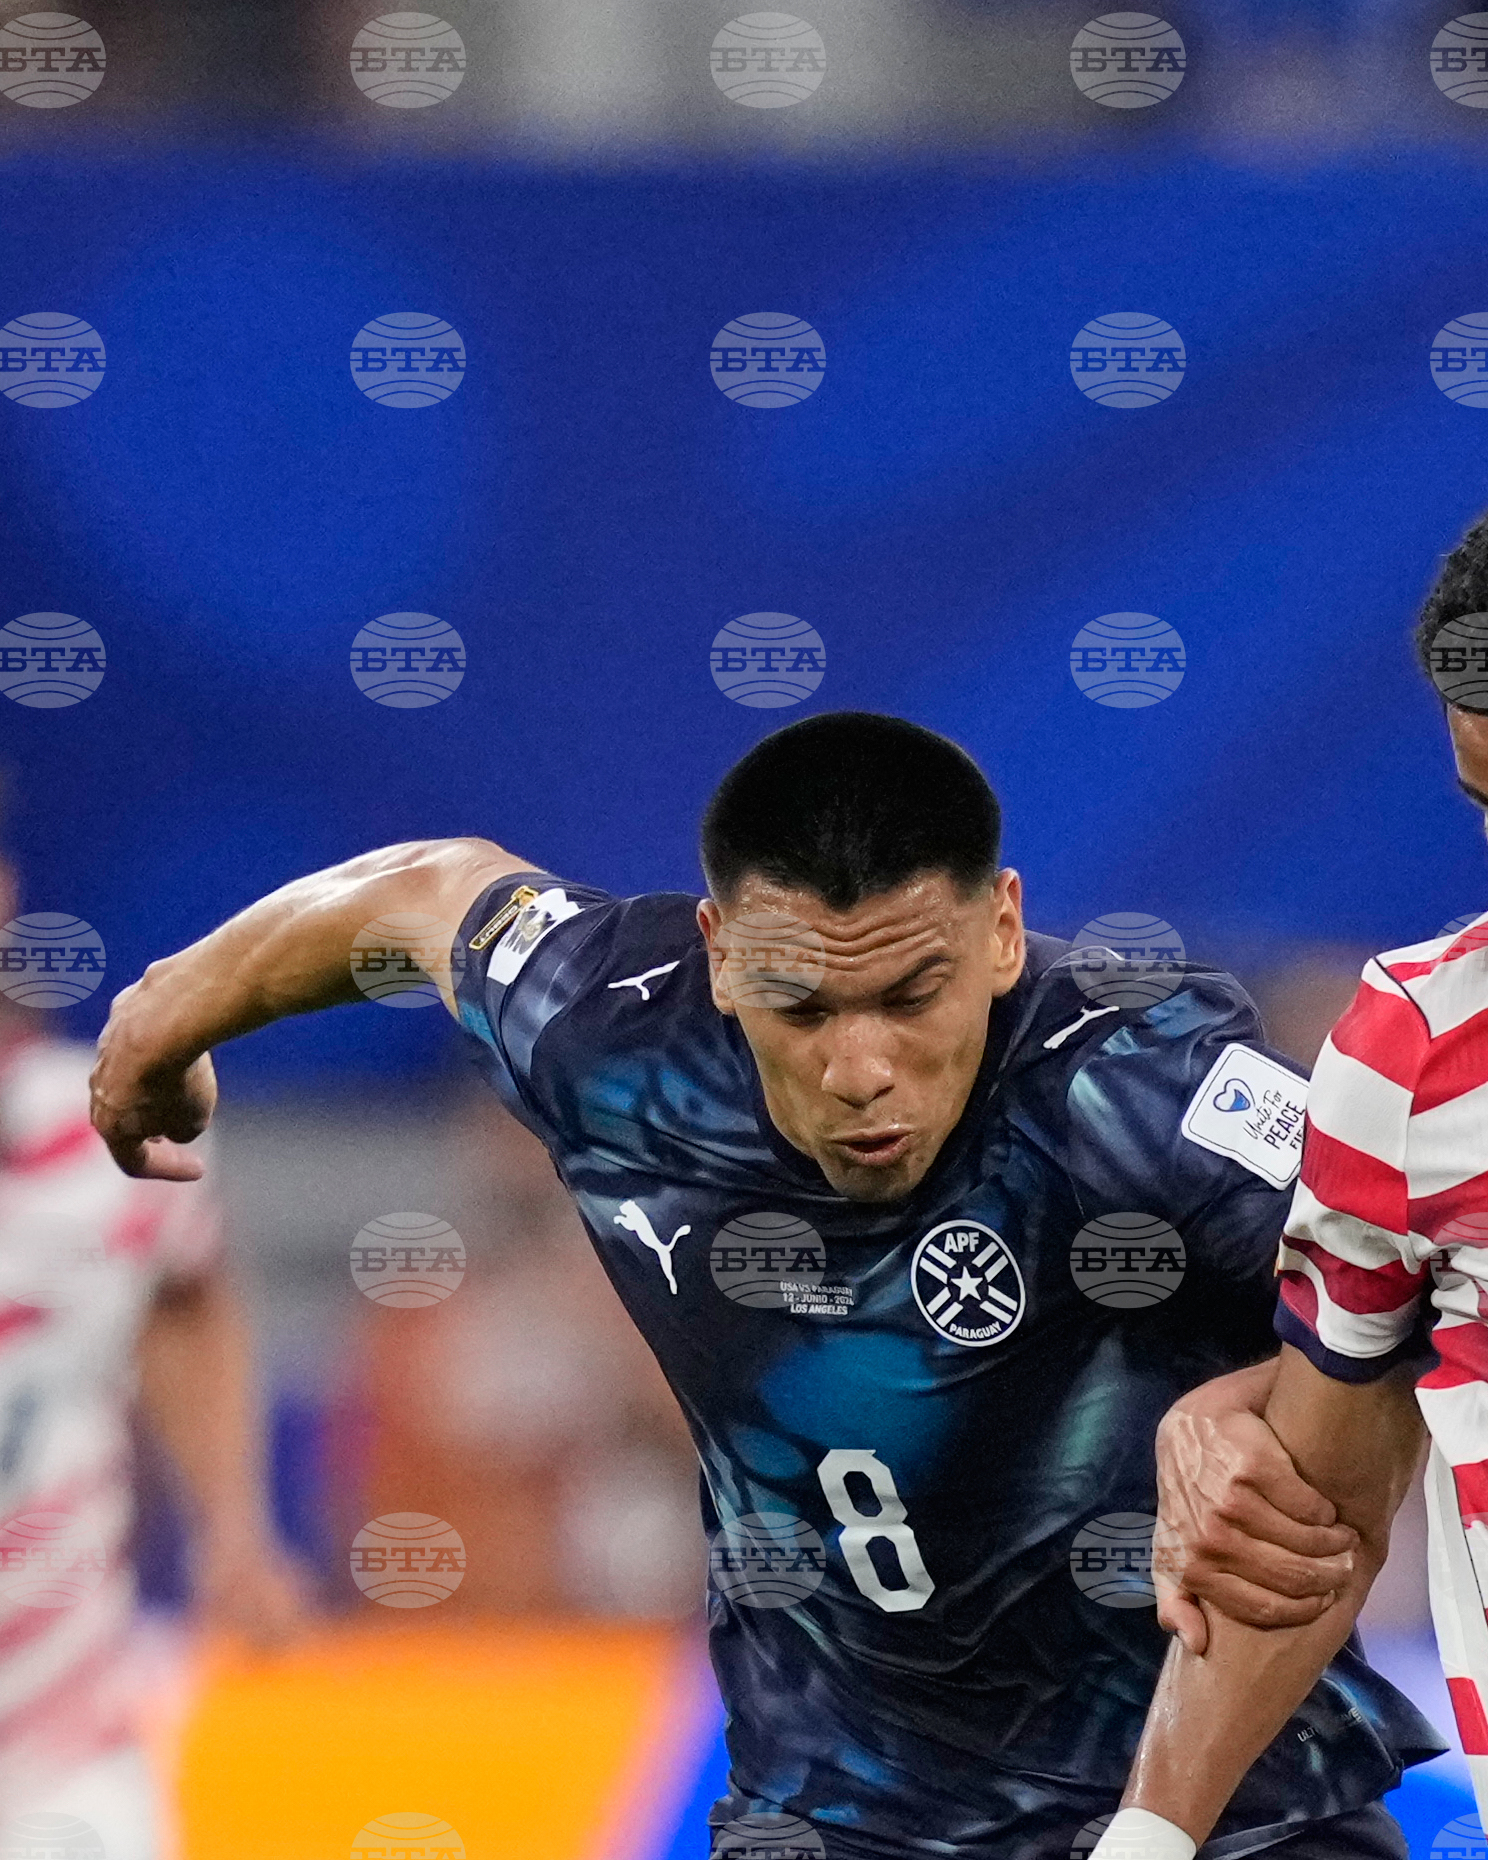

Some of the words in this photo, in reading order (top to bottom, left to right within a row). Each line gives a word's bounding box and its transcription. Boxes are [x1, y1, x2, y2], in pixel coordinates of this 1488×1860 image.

[1263, 1100, 1306, 1150] PEACE
[1289, 1126, 1304, 1150] FIF
[943, 1231, 980, 1253] APF
[779, 1281, 798, 1293] USA
[782, 1292, 794, 1303] 12
[790, 1303, 808, 1315] LOS
[808, 1304, 849, 1316] ANGELES
[949, 1321, 1002, 1339] PARAGUAY
[816, 1448, 936, 1613] 8
